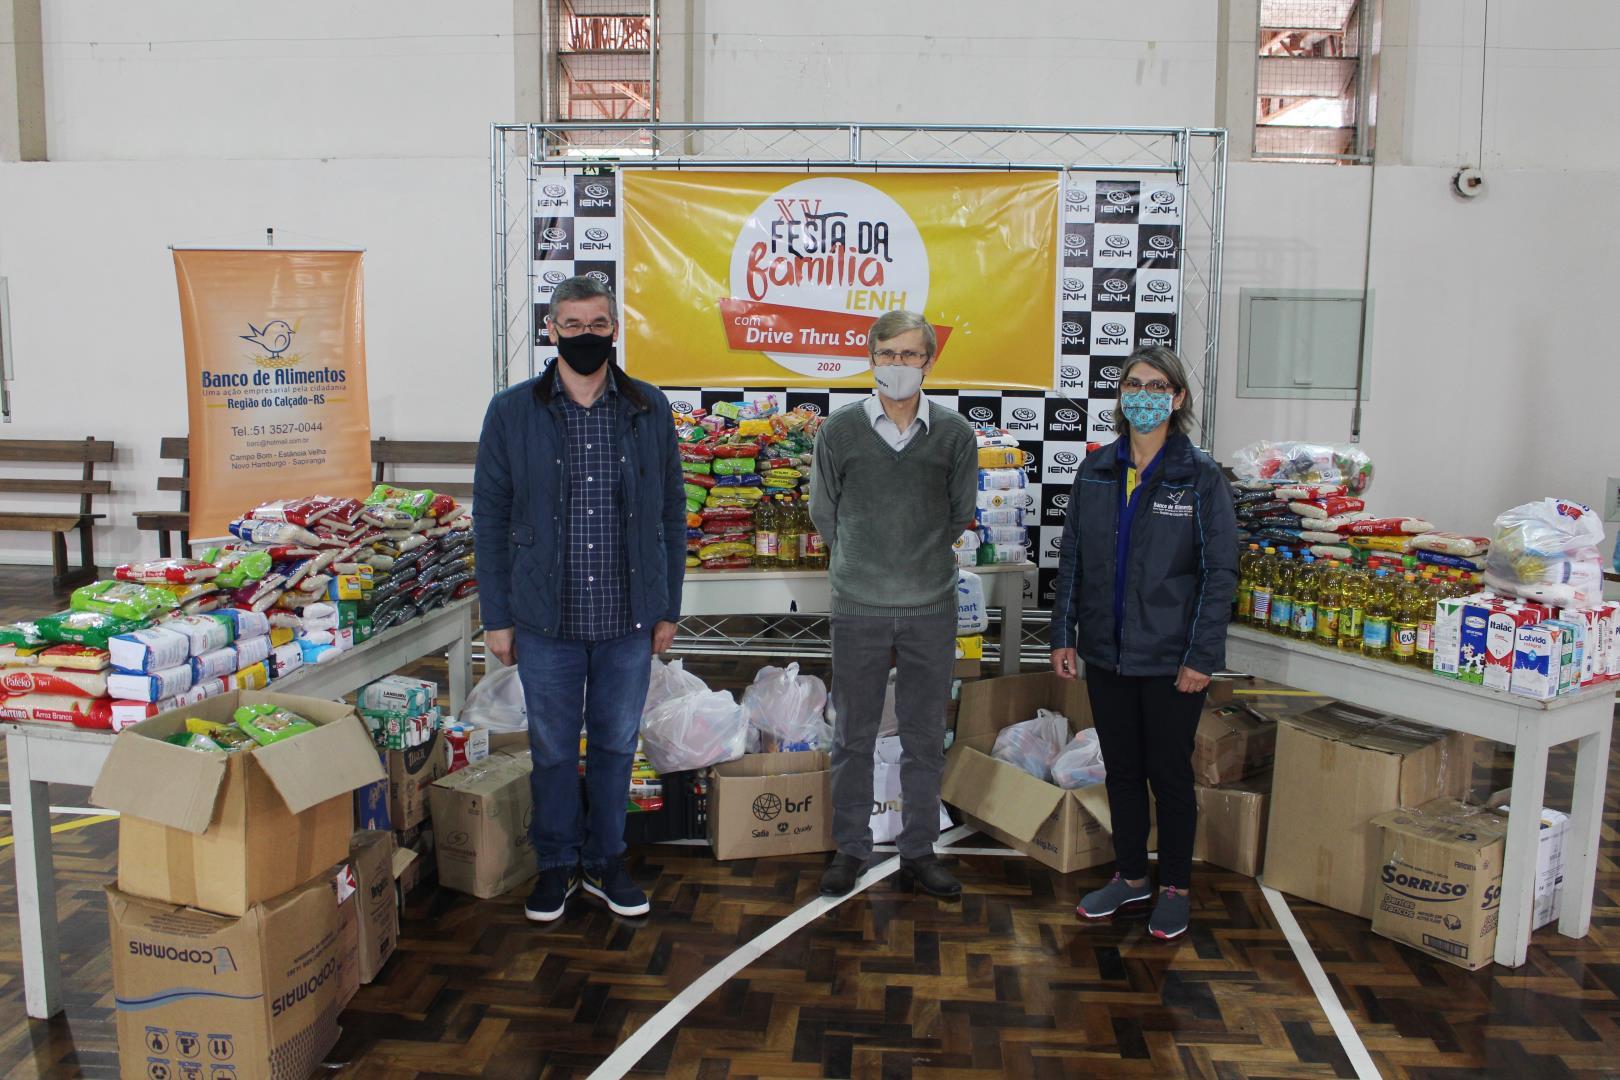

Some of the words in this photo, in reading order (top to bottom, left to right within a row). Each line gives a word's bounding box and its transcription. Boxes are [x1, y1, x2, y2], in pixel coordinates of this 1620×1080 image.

[580, 199, 611, 207] IENH
[1100, 205, 1134, 213] IENH
[774, 199, 822, 224] XV
[771, 211, 848, 259] FESTA
[858, 221, 893, 262] DA
[538, 242, 569, 250] IENH
[580, 242, 611, 250] IENH
[1100, 250, 1132, 258] IENH
[1143, 251, 1176, 259] IENH
[845, 290, 907, 311] IENH
[1098, 294, 1130, 302] IENH
[1141, 294, 1174, 303] IENH
[734, 316, 761, 326] com
[746, 327, 793, 344] Drive
[799, 328, 840, 346] Thru
[1096, 337, 1129, 346] IENH
[1139, 338, 1172, 347] IENH
[817, 362, 841, 372] 2020
[202, 370, 249, 388] Banco
[253, 369, 271, 386] de
[275, 366, 346, 385] Alimentos
[202, 389, 221, 397] Uma
[223, 388, 242, 396] ação
[244, 386, 291, 395] empresarial
[292, 384, 308, 393] pela
[310, 384, 346, 392] cidadania
[227, 397, 259, 411] Região
[261, 396, 273, 408] do
[275, 394, 326, 409] Calçado-RS
[269, 422, 323, 435] 3527-0044
[1006, 422, 1038, 431] IENH
[1049, 423, 1082, 432] IENH
[230, 454, 255, 462] Campo
[256, 452, 273, 460] Bom
[307, 448, 327, 456] Velha
[231, 462, 250, 470] Novo
[252, 460, 287, 469] Hamburgo
[292, 457, 326, 466] Sapiranga
[1490, 621, 1513, 633] Italac
[1519, 633, 1547, 645] Latvida
[35, 711, 52, 720] Arroz
[52, 712, 73, 721] Branco
[785, 795, 813, 813] brf
[1381, 864, 1467, 896] SORRISO
[129, 940, 213, 964] COPOMAIS
[271, 957, 336, 1018] COPOMAIS
